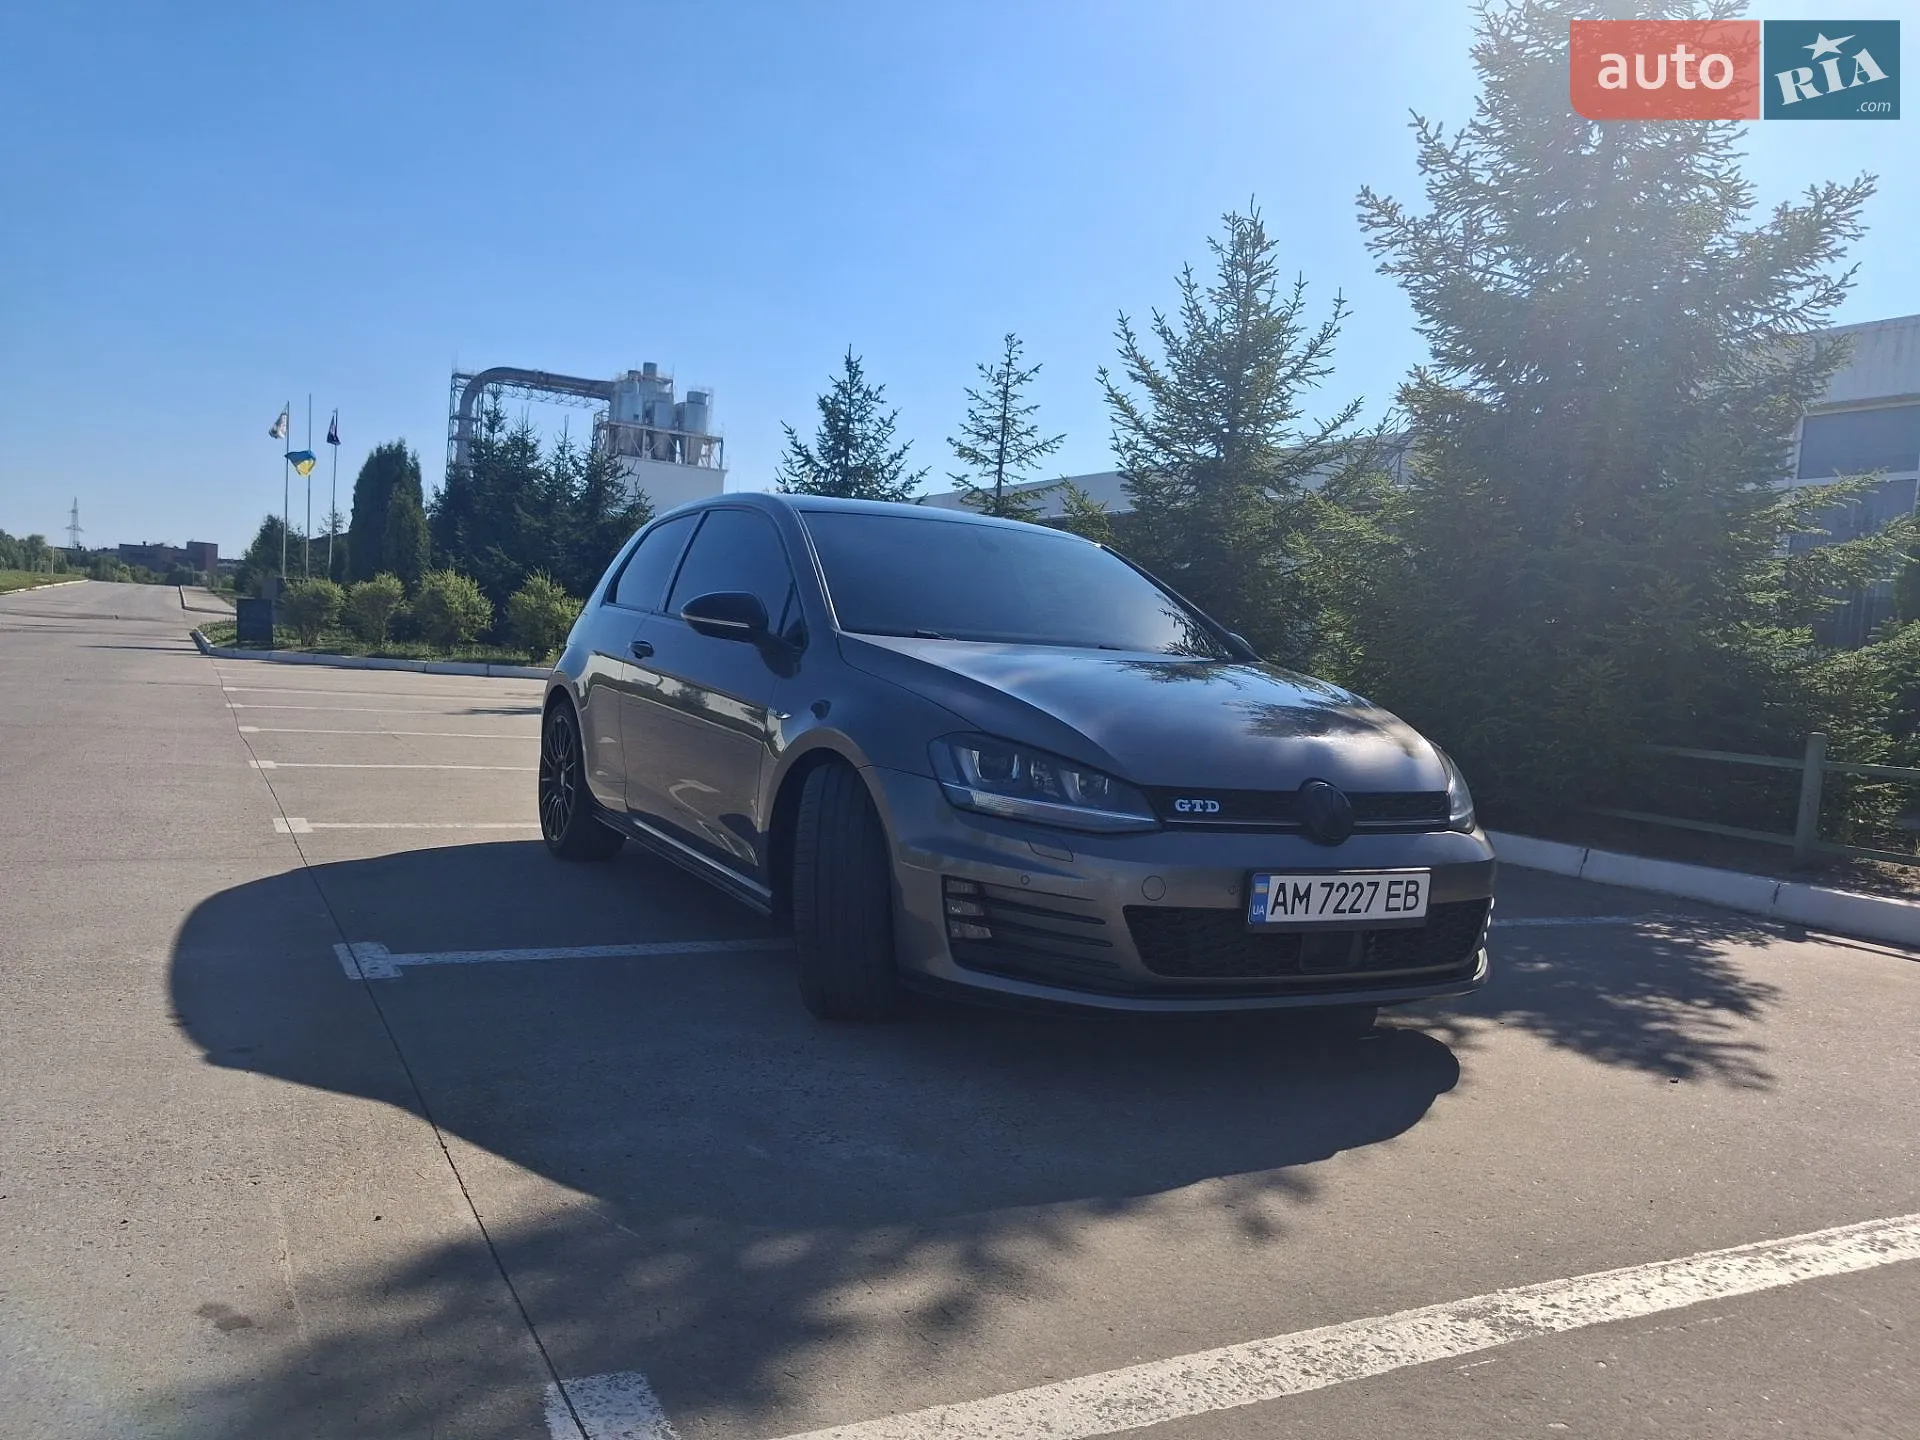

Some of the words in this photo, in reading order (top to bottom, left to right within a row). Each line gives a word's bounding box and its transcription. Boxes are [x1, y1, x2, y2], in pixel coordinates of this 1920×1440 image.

[1174, 799, 1220, 813] GTD
[1270, 882, 1312, 915] AM
[1318, 881, 1380, 914] 7227
[1385, 880, 1420, 912] EB
[1252, 906, 1265, 915] UA
